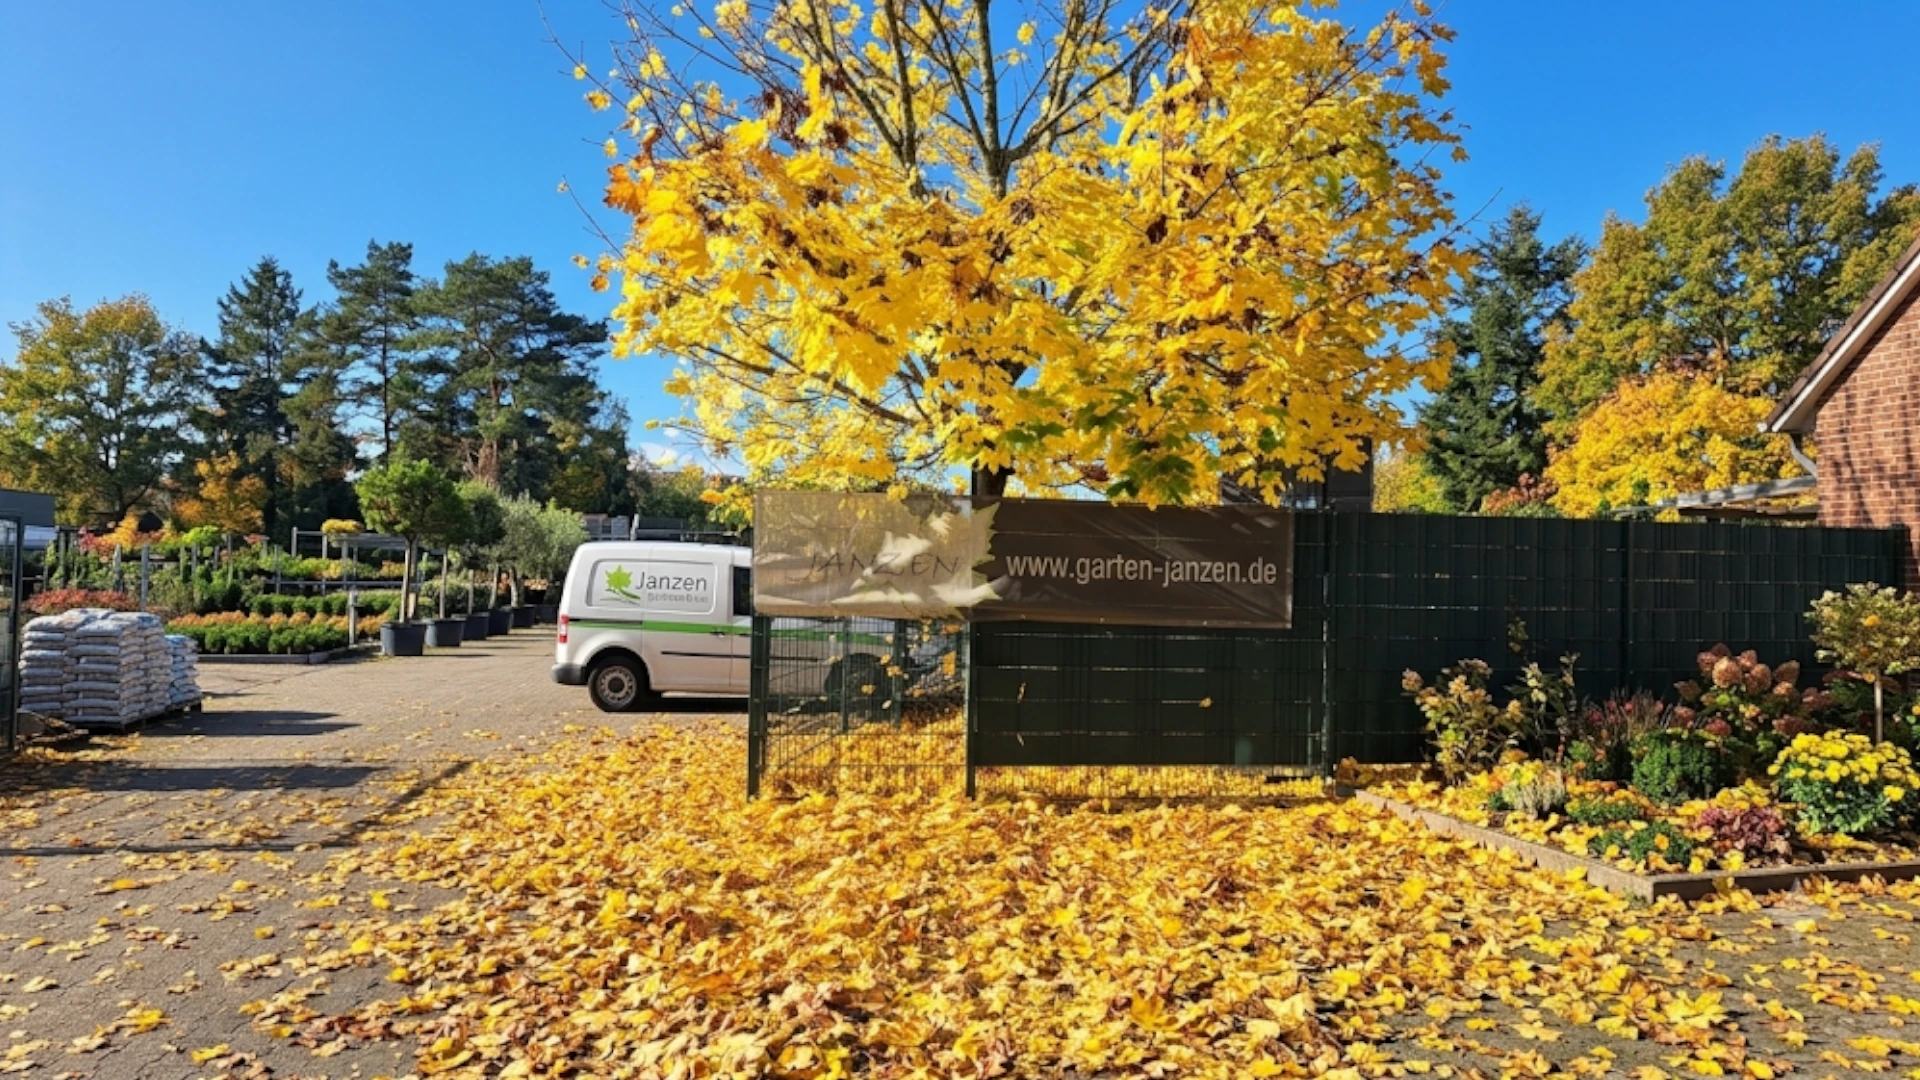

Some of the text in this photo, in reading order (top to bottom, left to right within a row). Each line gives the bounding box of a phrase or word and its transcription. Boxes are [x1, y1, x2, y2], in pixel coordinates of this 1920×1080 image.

[635, 571, 707, 592] Janzen
[786, 552, 959, 582] JANZEN
[1006, 554, 1277, 587] www.garten-janzen.de
